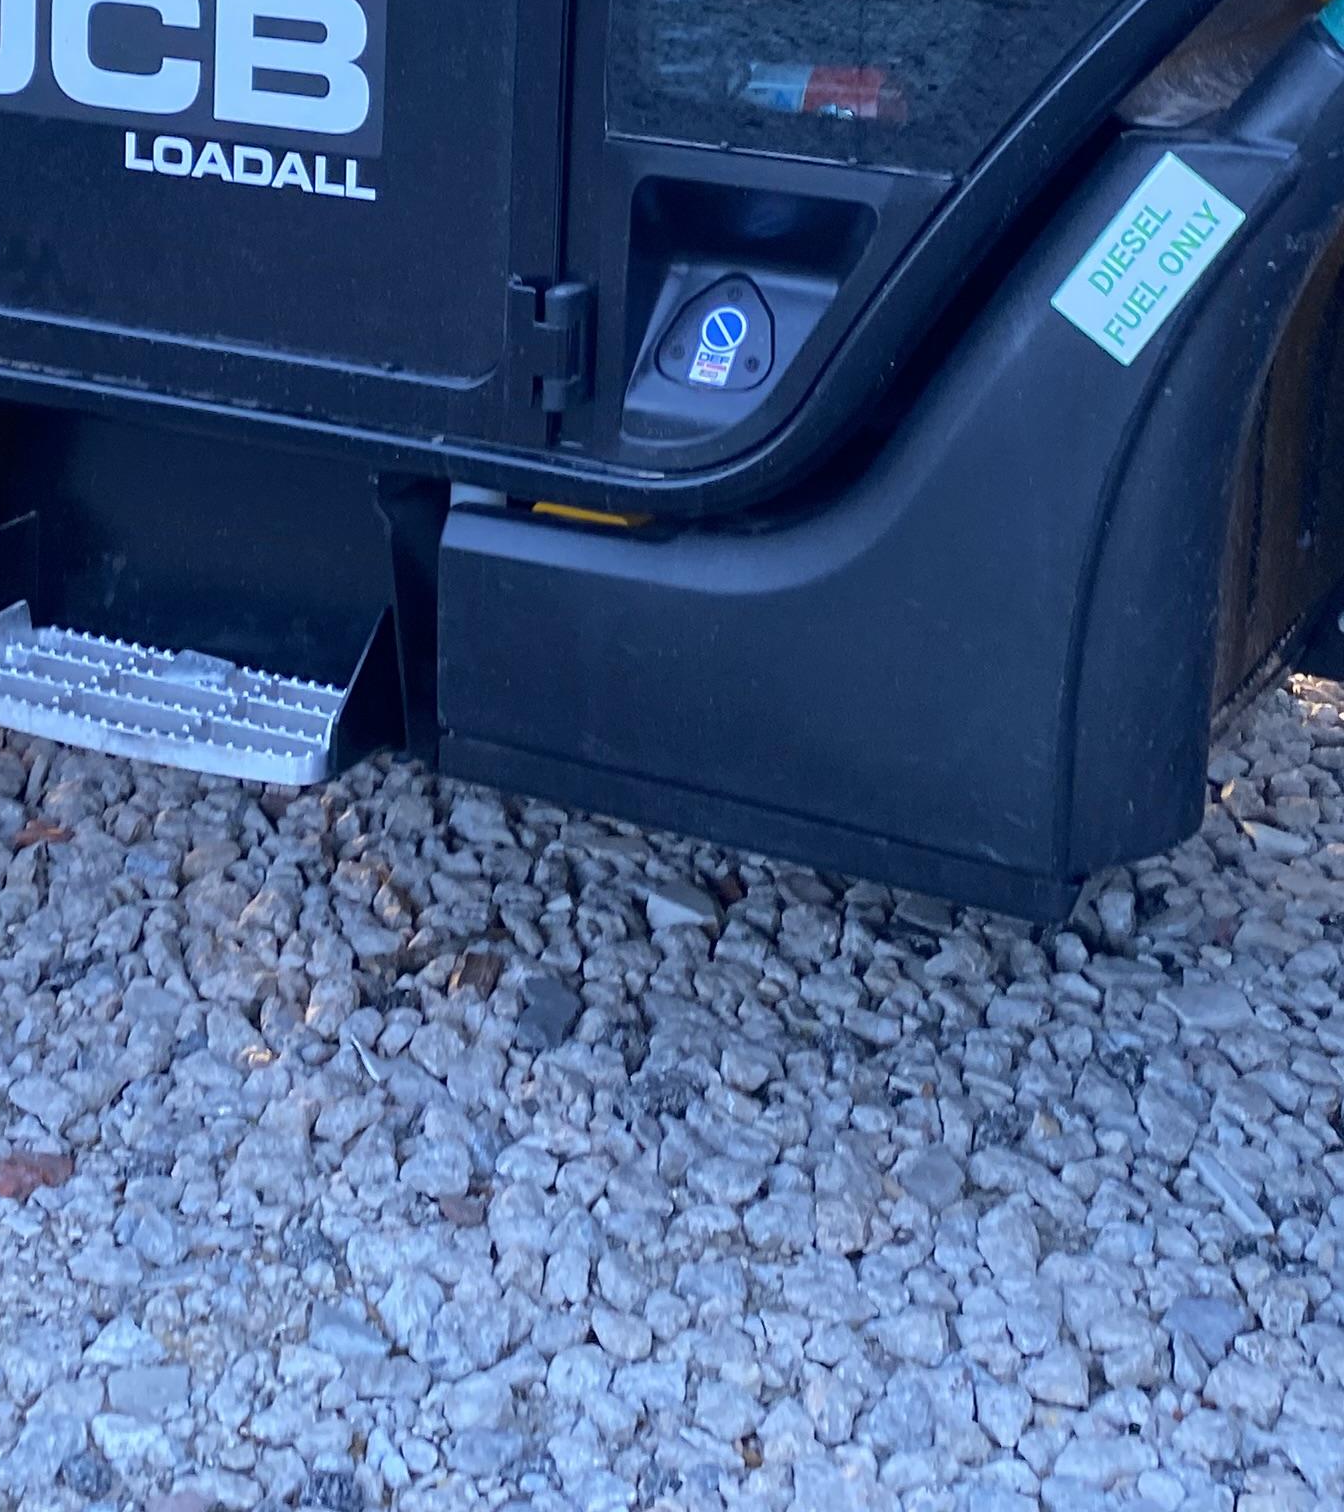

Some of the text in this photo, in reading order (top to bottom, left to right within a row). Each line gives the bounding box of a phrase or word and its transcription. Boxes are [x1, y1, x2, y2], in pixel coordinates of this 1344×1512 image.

[125, 132, 376, 201] LOADALL
[1088, 204, 1172, 297] DIESEL
[1103, 199, 1221, 347] FUEL ONLY
[698, 351, 731, 364] DEF
